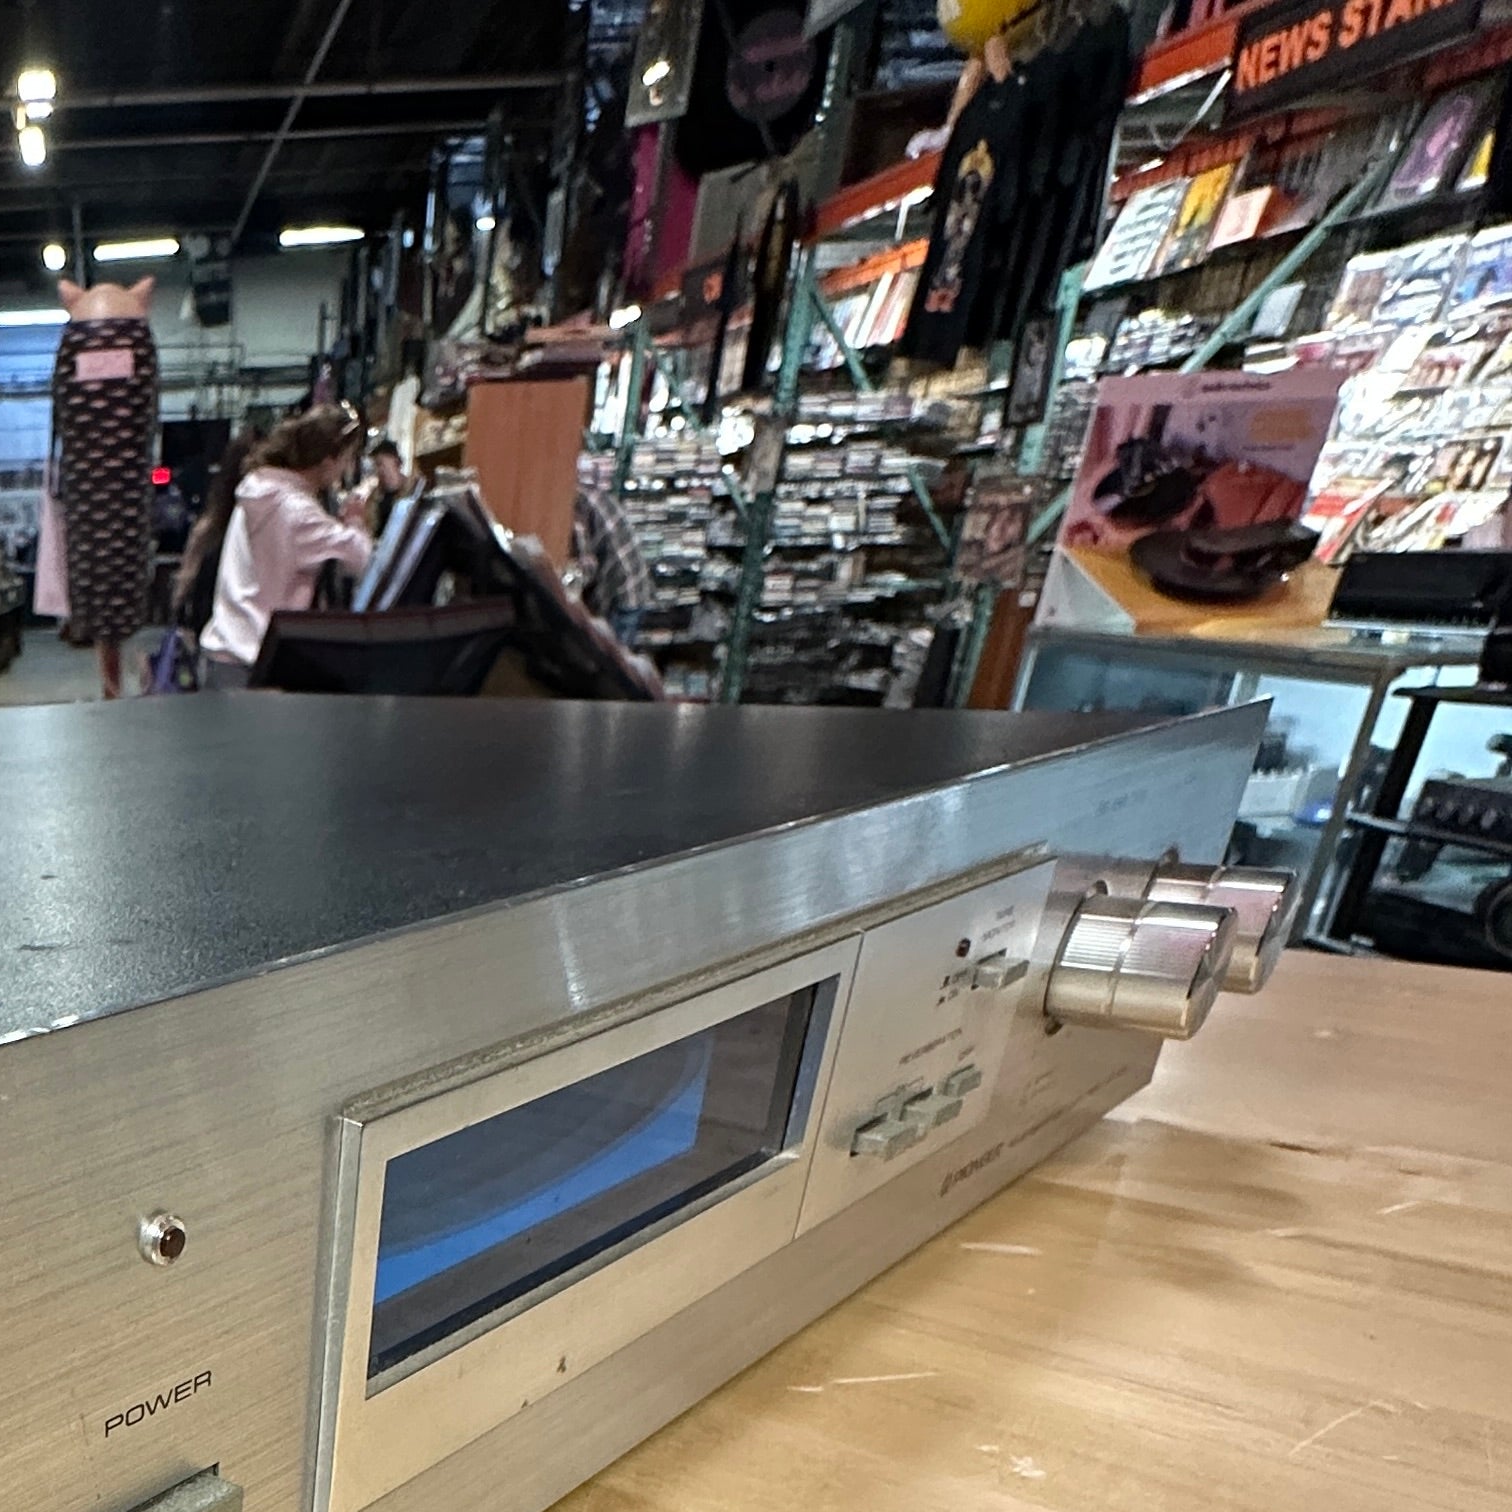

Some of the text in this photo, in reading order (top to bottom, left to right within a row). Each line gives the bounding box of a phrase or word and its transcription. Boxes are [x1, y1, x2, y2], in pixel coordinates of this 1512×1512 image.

[1235, 0, 1455, 92] NEWS STA
[104, 1370, 212, 1438] POWER
